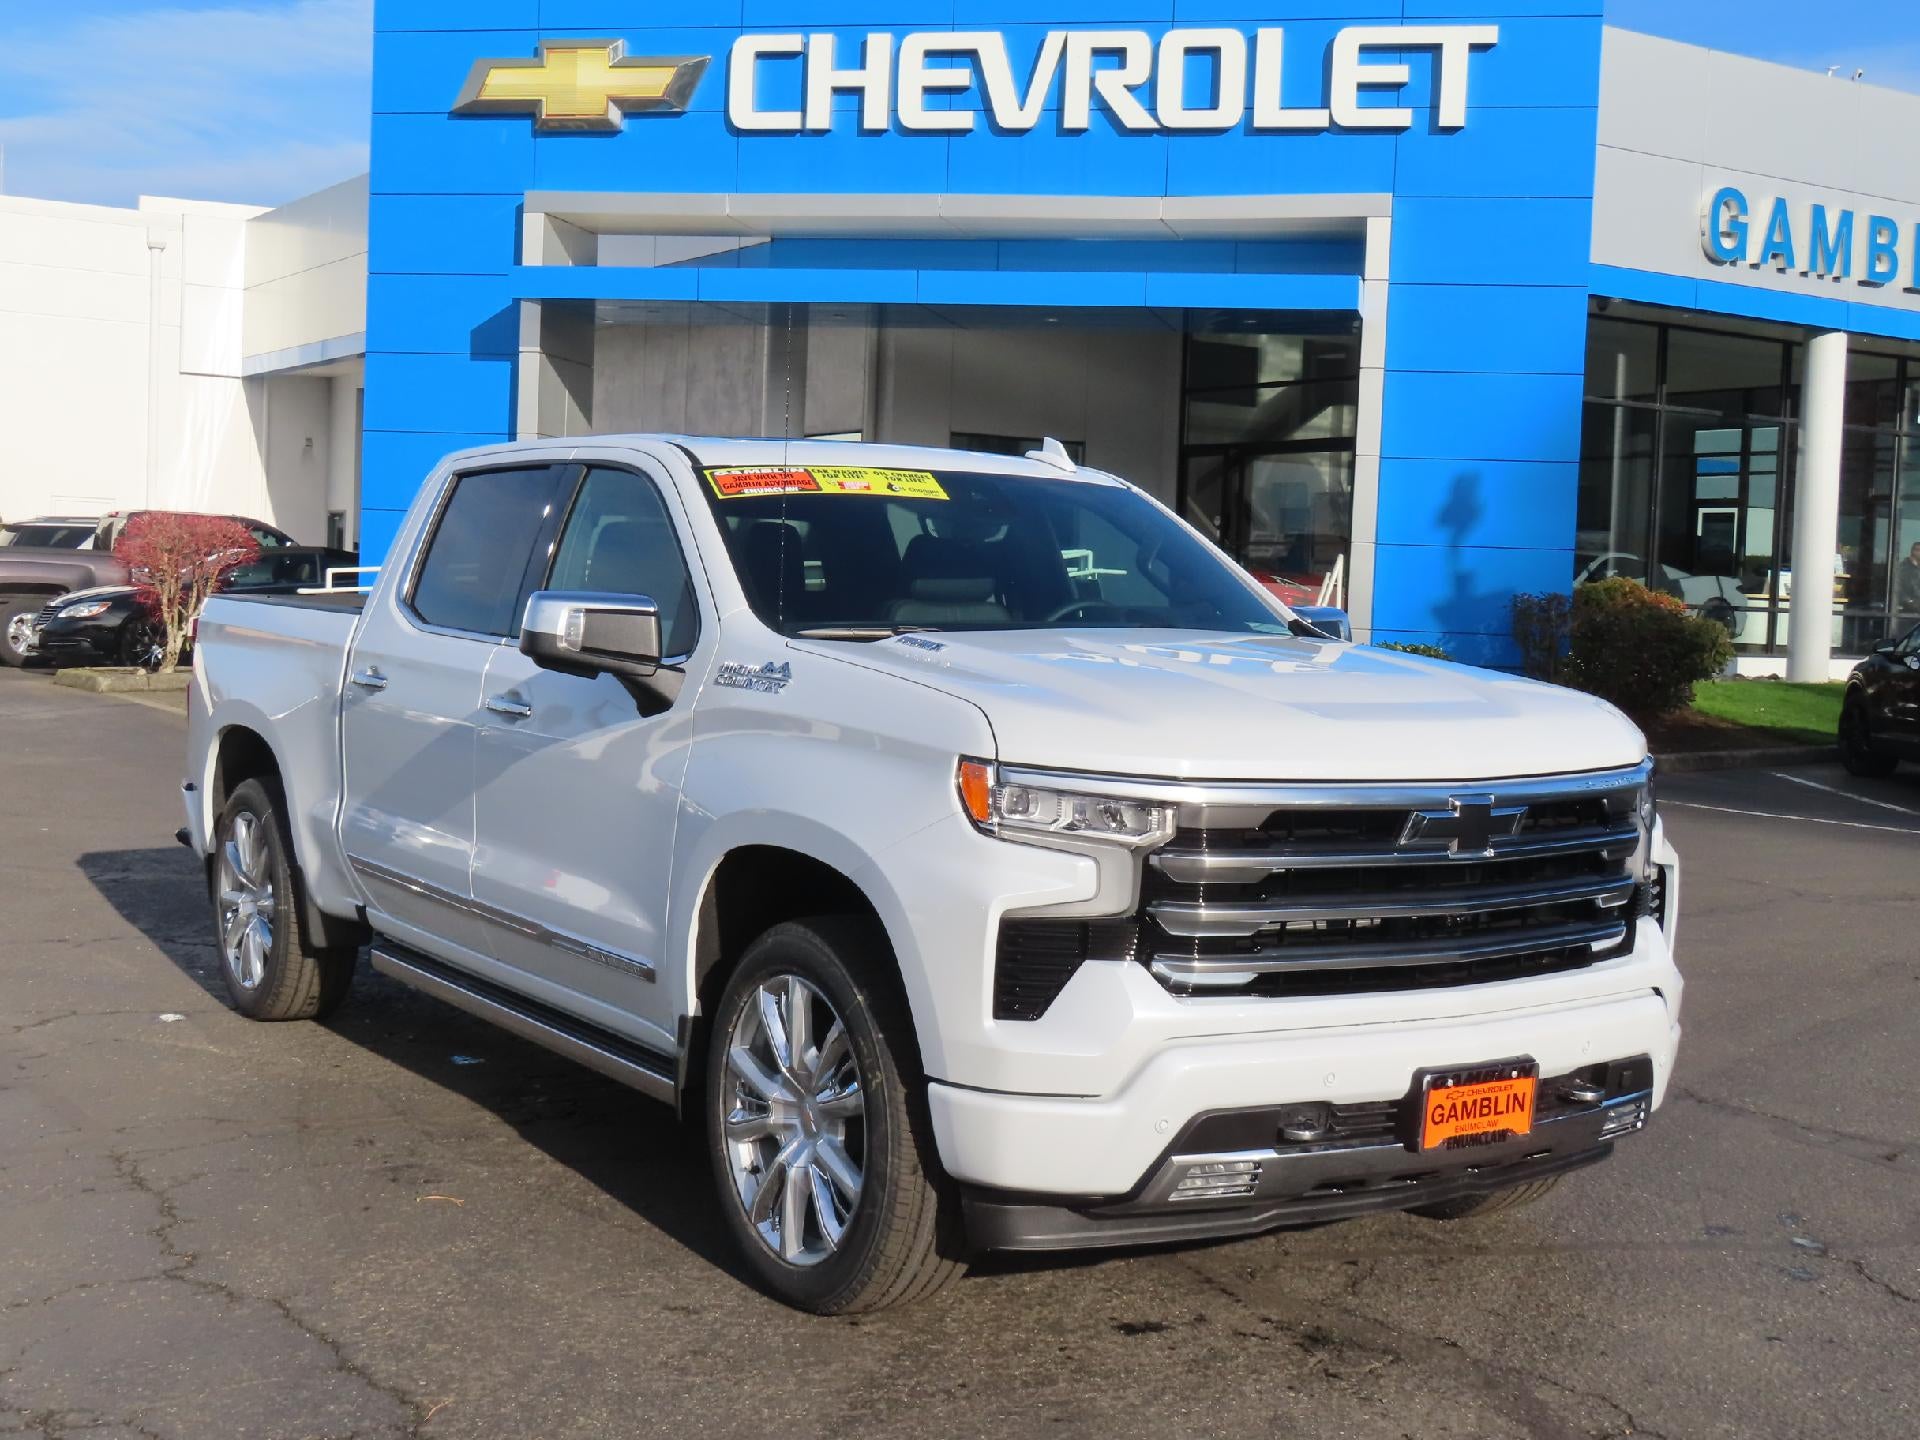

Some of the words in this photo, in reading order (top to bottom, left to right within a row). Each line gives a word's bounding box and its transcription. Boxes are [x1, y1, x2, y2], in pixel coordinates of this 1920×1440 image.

[727, 24, 1499, 131] CHEVROLET
[722, 480, 762, 489] GAMBLIN
[763, 479, 813, 488] ADVANTAGE
[1466, 1084, 1514, 1097] CHEVROLET
[1431, 1092, 1526, 1126] GAMBLIN
[1455, 1119, 1499, 1133] ENUMCLAW
